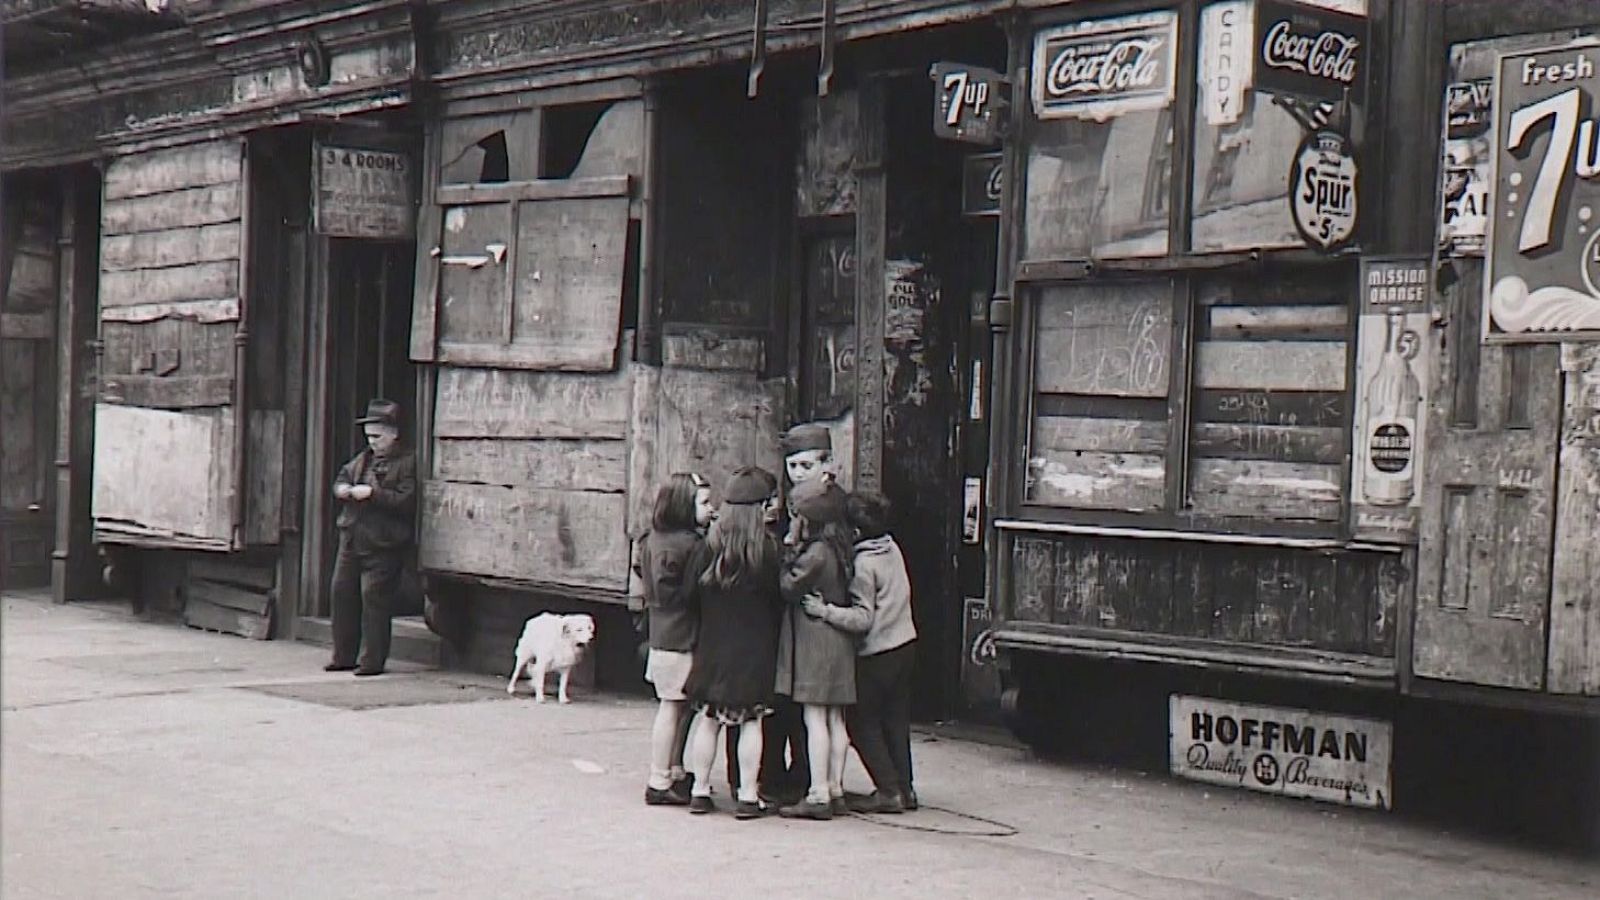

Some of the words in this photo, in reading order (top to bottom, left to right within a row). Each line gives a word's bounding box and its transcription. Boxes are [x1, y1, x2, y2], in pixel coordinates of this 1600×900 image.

[1047, 37, 1164, 95] Coca-Cola
[1263, 20, 1360, 83] Coca-Cola
[1303, 166, 1351, 214] Spur
[1368, 269, 1427, 285] MISSION
[1370, 286, 1425, 303] ORANGE
[1191, 712, 1367, 763] HOFFMAN
[1187, 743, 1248, 783] Quality
[1285, 756, 1369, 800] Beverages
